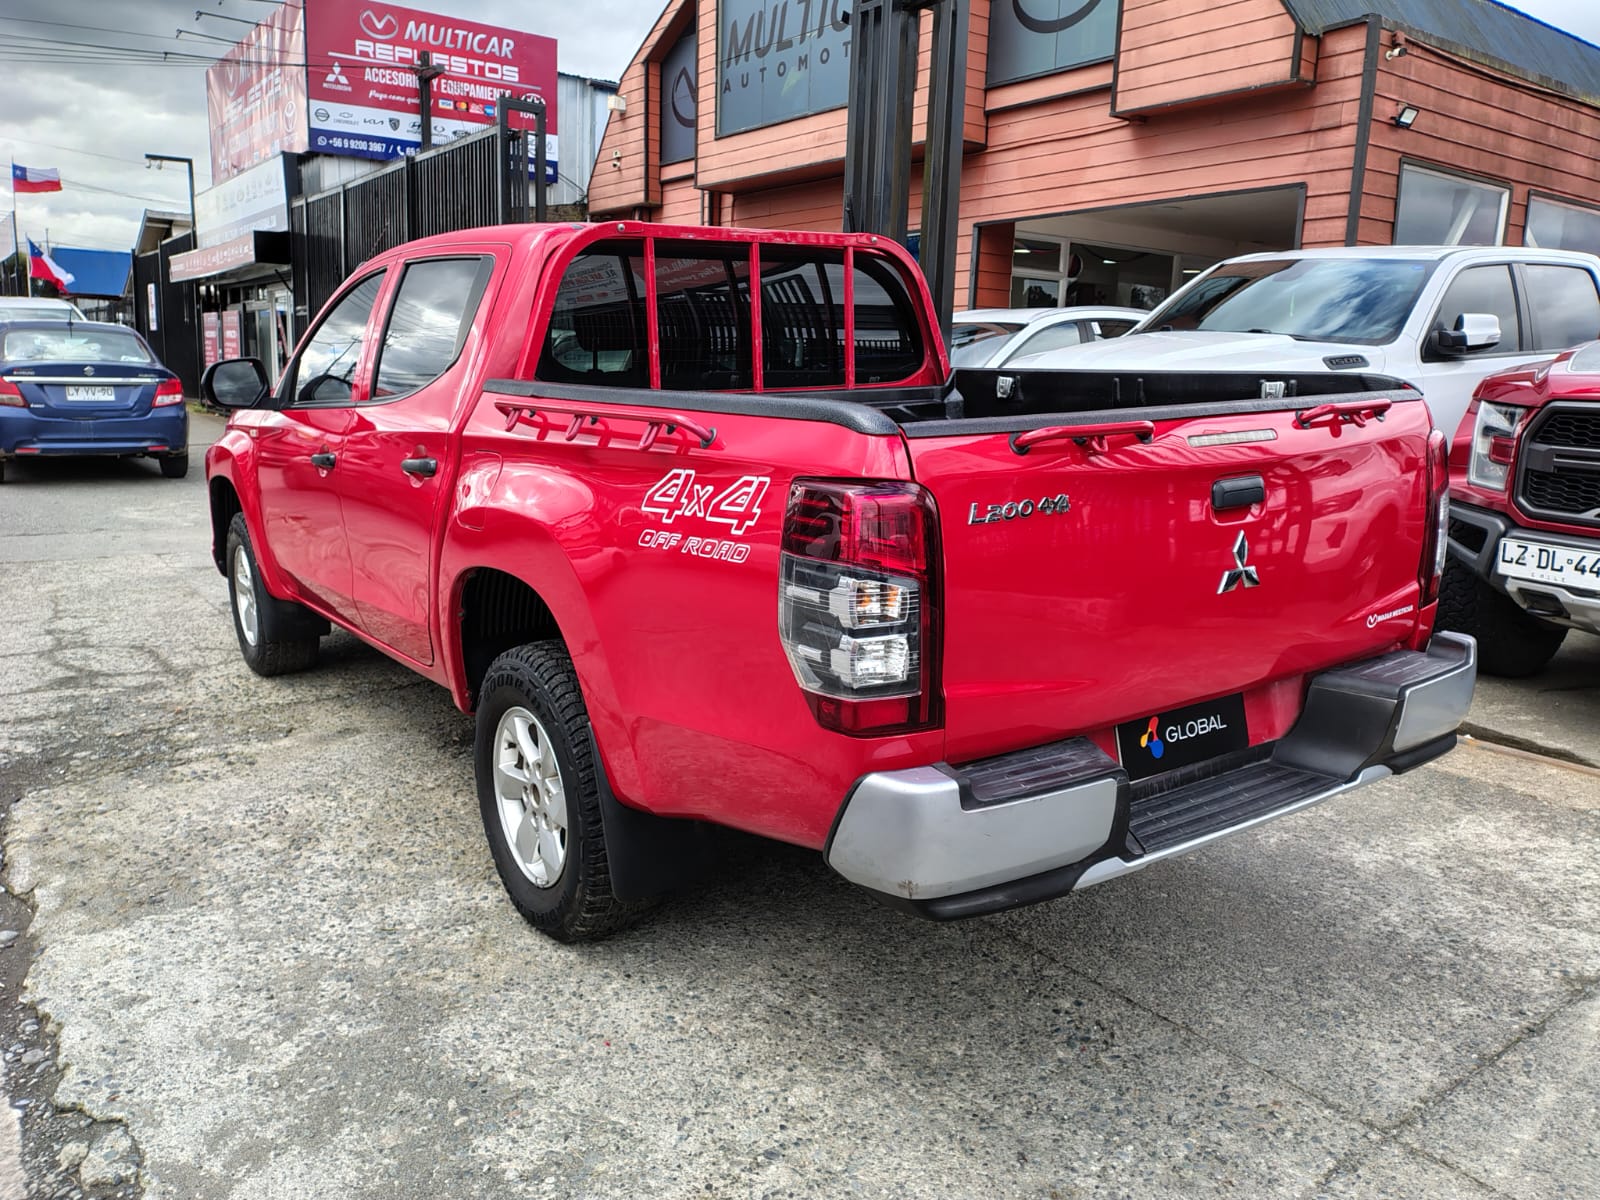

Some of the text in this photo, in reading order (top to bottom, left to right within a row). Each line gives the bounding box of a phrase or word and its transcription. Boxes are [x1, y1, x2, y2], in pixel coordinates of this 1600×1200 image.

[404, 20, 515, 59] MULTICAR
[726, 0, 852, 69] MULTIC
[364, 67, 421, 89] ACCESORI
[432, 78, 439, 92] Y
[723, 40, 852, 94] AUTOMOT
[328, 137, 342, 148] +56
[641, 468, 771, 535] 4x4
[968, 499, 1034, 525] L200
[638, 529, 751, 563] OFF ROAD
[1165, 714, 1228, 743] GLOBAL
